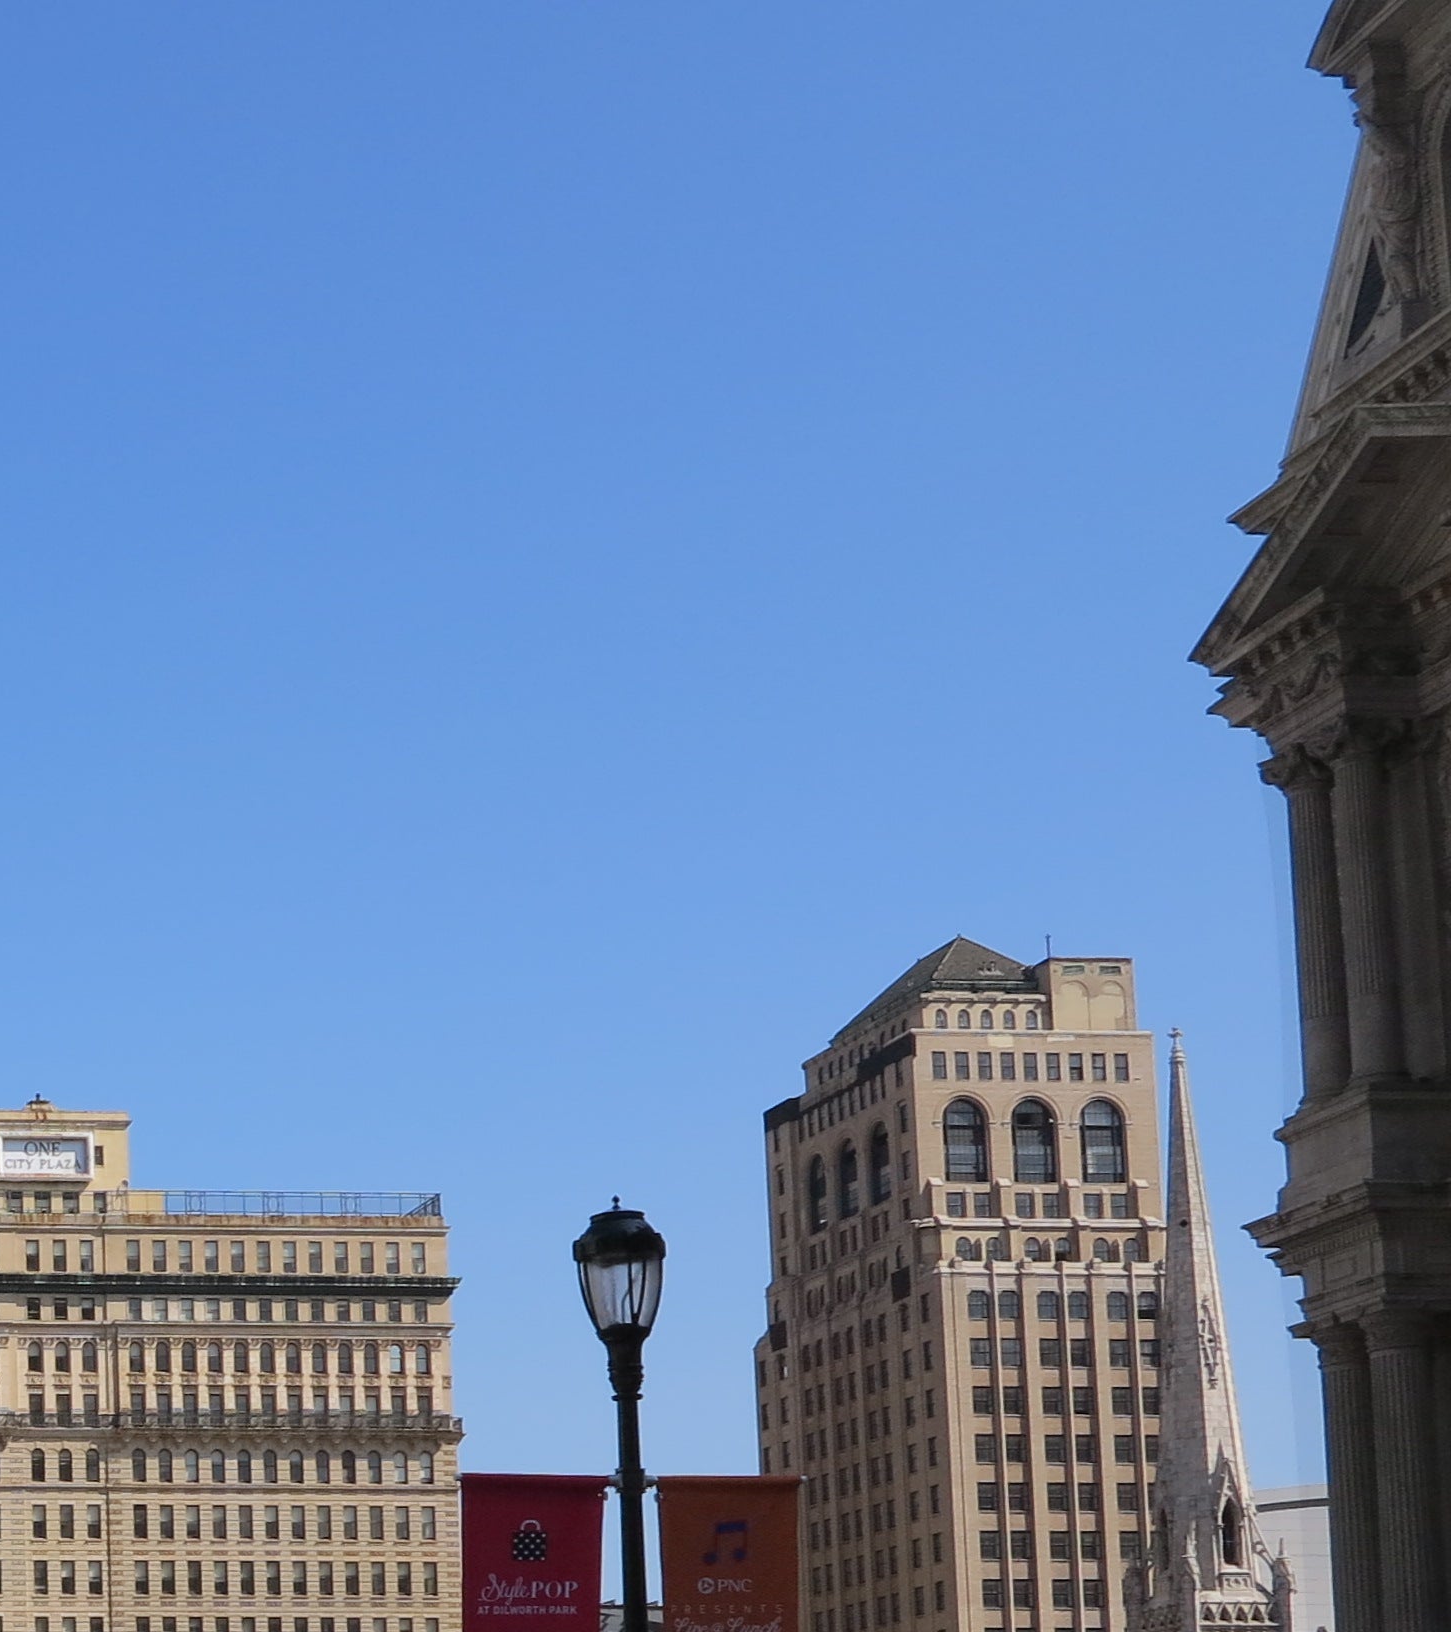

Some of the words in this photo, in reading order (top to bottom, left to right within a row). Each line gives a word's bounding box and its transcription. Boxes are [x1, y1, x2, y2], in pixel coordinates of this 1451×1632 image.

[24, 1141, 62, 1157] ONE
[4, 1158, 35, 1171] CITY
[39, 1158, 82, 1171] PLAZA
[717, 1578, 753, 1593] PNC
[476, 1605, 490, 1616] AT
[492, 1605, 547, 1616] DILWORTH
[548, 1605, 578, 1616] PARK
[670, 1603, 785, 1615] PRESENTS
